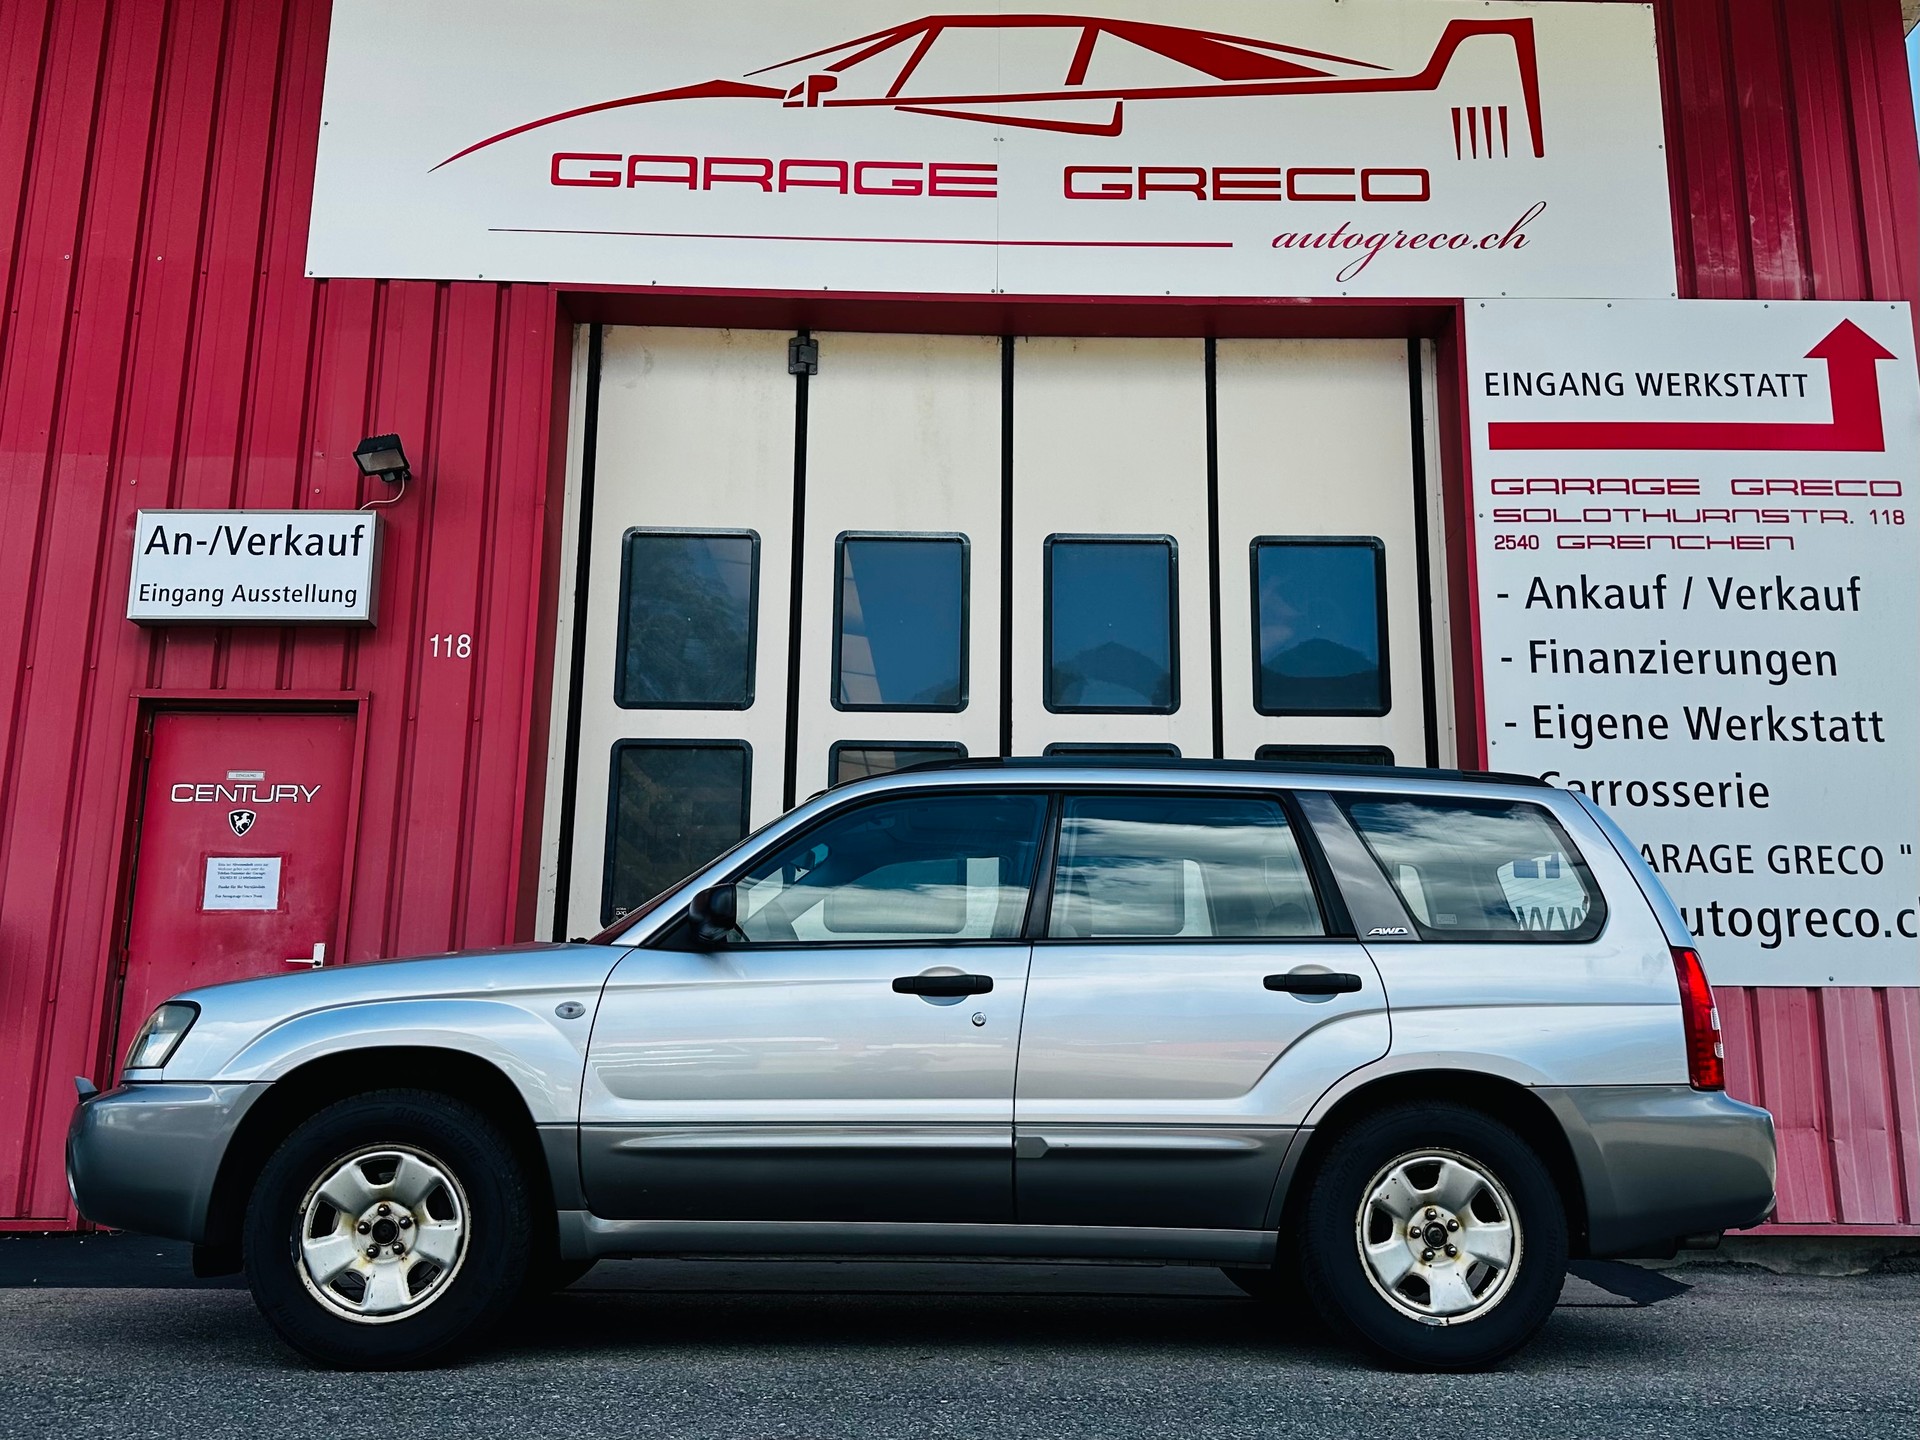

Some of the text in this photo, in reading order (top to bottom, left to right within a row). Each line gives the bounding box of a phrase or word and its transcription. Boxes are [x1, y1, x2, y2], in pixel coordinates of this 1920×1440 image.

[550, 152, 1431, 202] GARAGE GRECO
[1272, 201, 1547, 283] autogreco.ch
[1485, 372, 1808, 398] EINGANG WERKSTATT
[1490, 478, 1902, 497] GARAGE GRECO
[1493, 508, 1905, 525] SOLOTHURNSTR. 118
[144, 524, 365, 557] An-/Verkauf
[1494, 535, 1794, 550] 2540 GRENCHEN
[139, 583, 357, 608] Eingang Ausstellung
[1524, 574, 1667, 610] Ankauf
[1706, 575, 1861, 612] Verkauf
[430, 633, 471, 658] 118
[1529, 638, 1837, 686] Finanzierungen
[1533, 704, 1669, 750] Eigene
[1682, 704, 1886, 743] Werkstatt
[171, 783, 322, 803] CENTURY
[1640, 843, 1754, 874] ARAGE
[1767, 844, 1884, 876] GRECO
[1367, 927, 1408, 935] AWD
